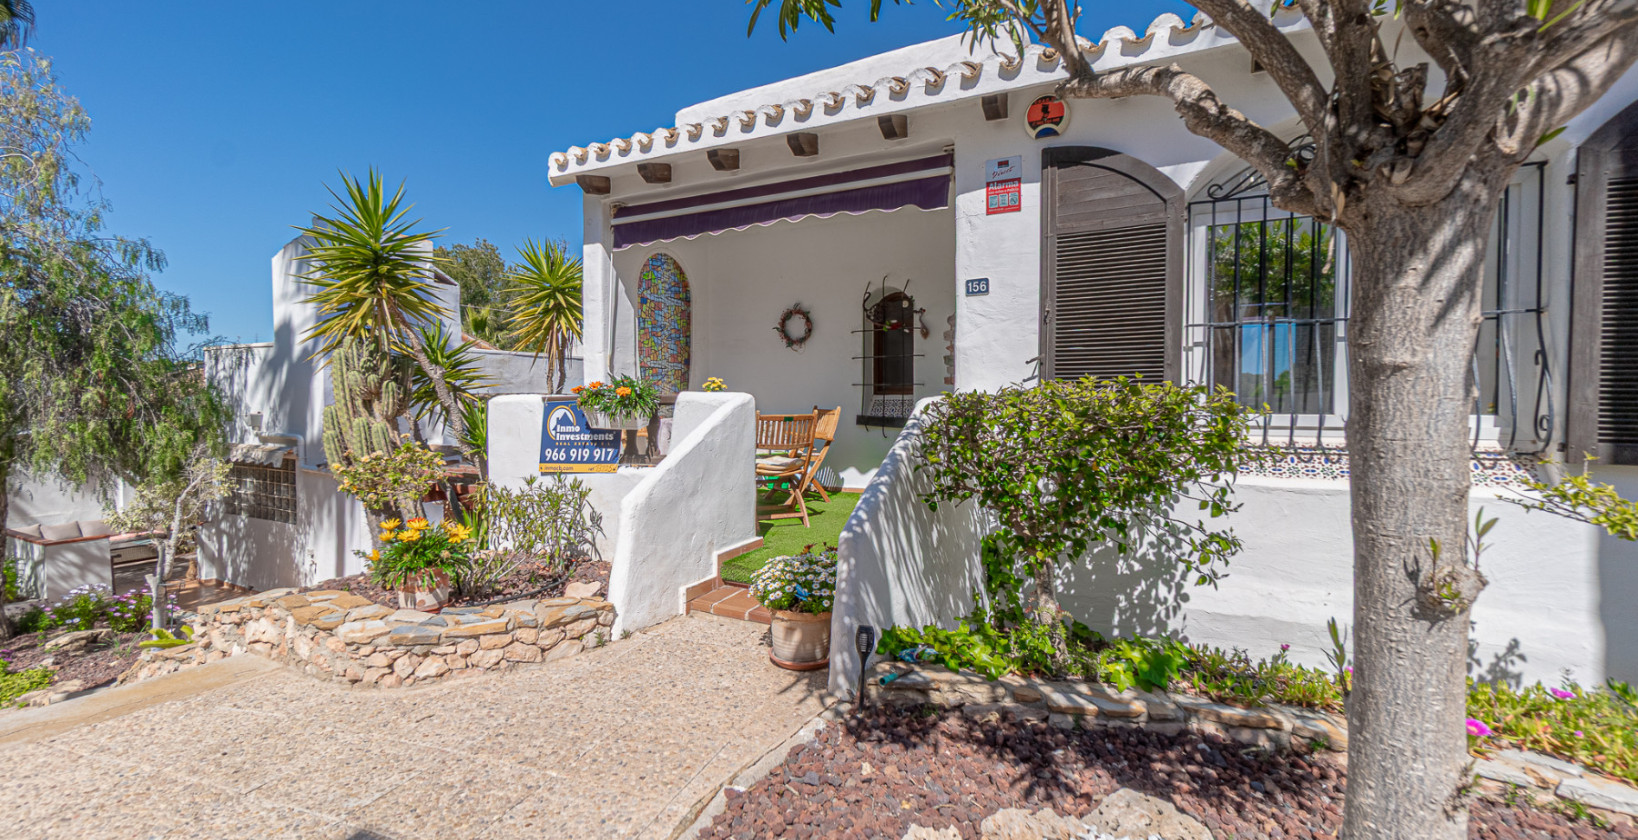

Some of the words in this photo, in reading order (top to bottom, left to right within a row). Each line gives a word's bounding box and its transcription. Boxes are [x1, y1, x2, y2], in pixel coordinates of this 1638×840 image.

[989, 180, 1019, 191] Alarma
[967, 281, 987, 293] 156
[555, 432, 614, 441] Investments
[545, 448, 566, 461] 966
[570, 448, 590, 461] 919
[593, 448, 614, 461] 917
